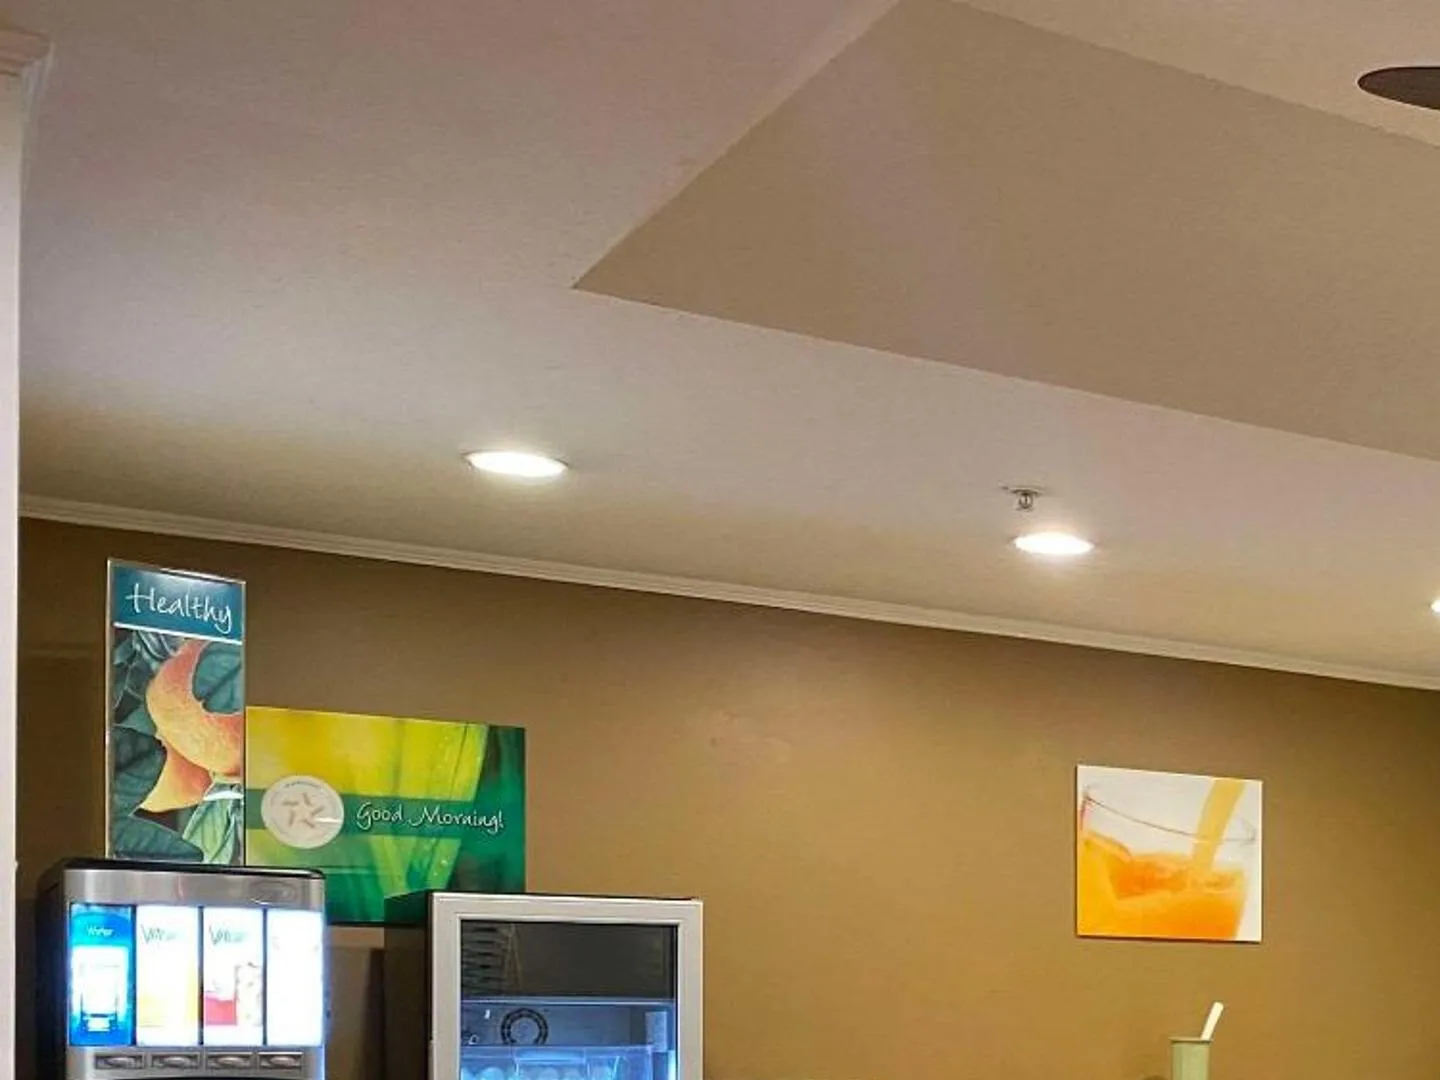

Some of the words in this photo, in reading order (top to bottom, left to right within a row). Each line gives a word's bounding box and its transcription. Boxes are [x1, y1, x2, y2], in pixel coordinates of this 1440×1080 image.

[125, 583, 232, 634] Healthy
[356, 802, 402, 831] Good
[408, 806, 504, 836] Morning!
